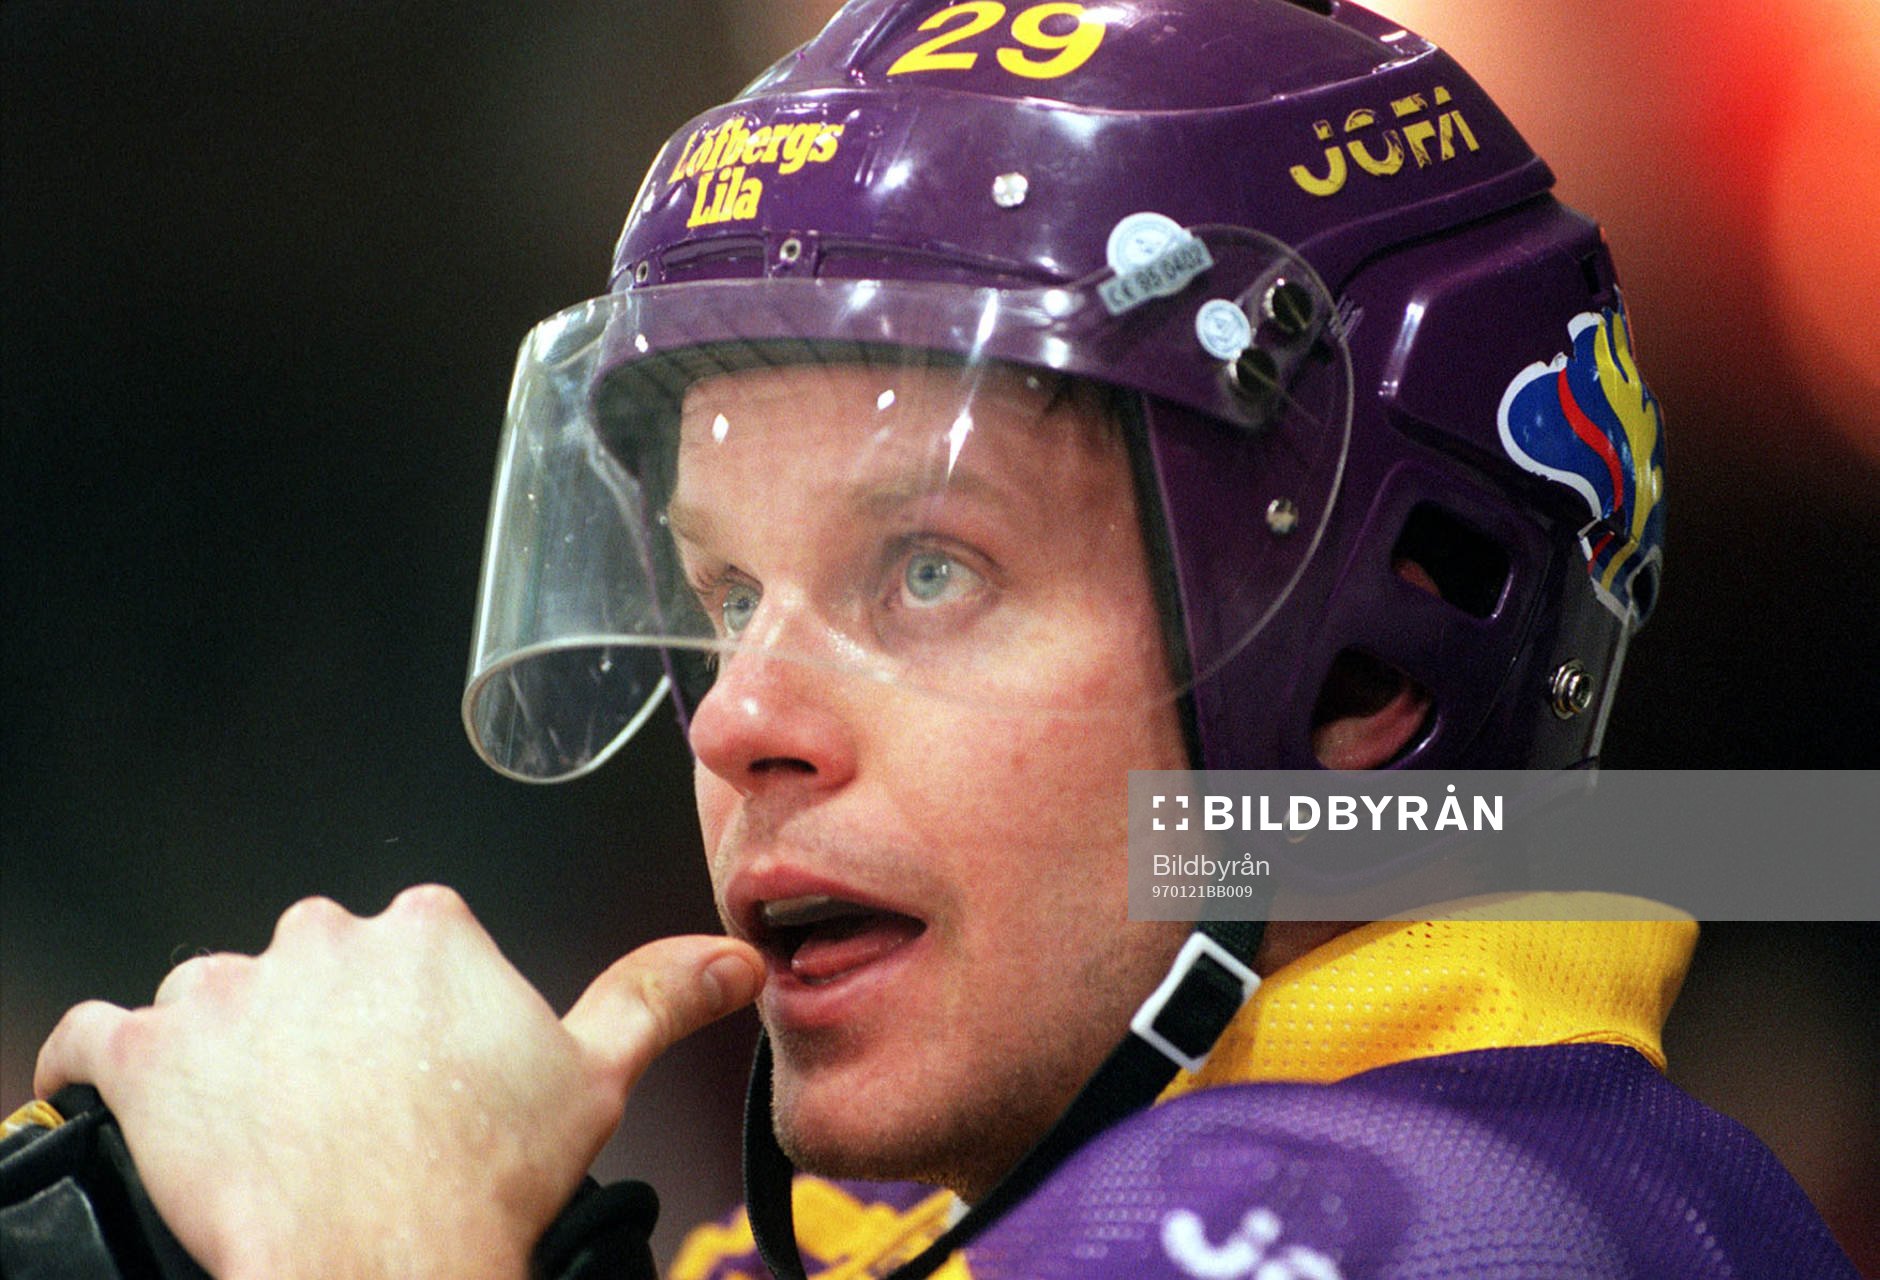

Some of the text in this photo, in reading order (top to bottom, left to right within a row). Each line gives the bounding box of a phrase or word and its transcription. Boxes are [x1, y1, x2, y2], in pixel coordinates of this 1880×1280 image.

[886, 1, 1106, 79] 29
[1289, 86, 1480, 196] JOFA
[686, 166, 763, 228] Lila
